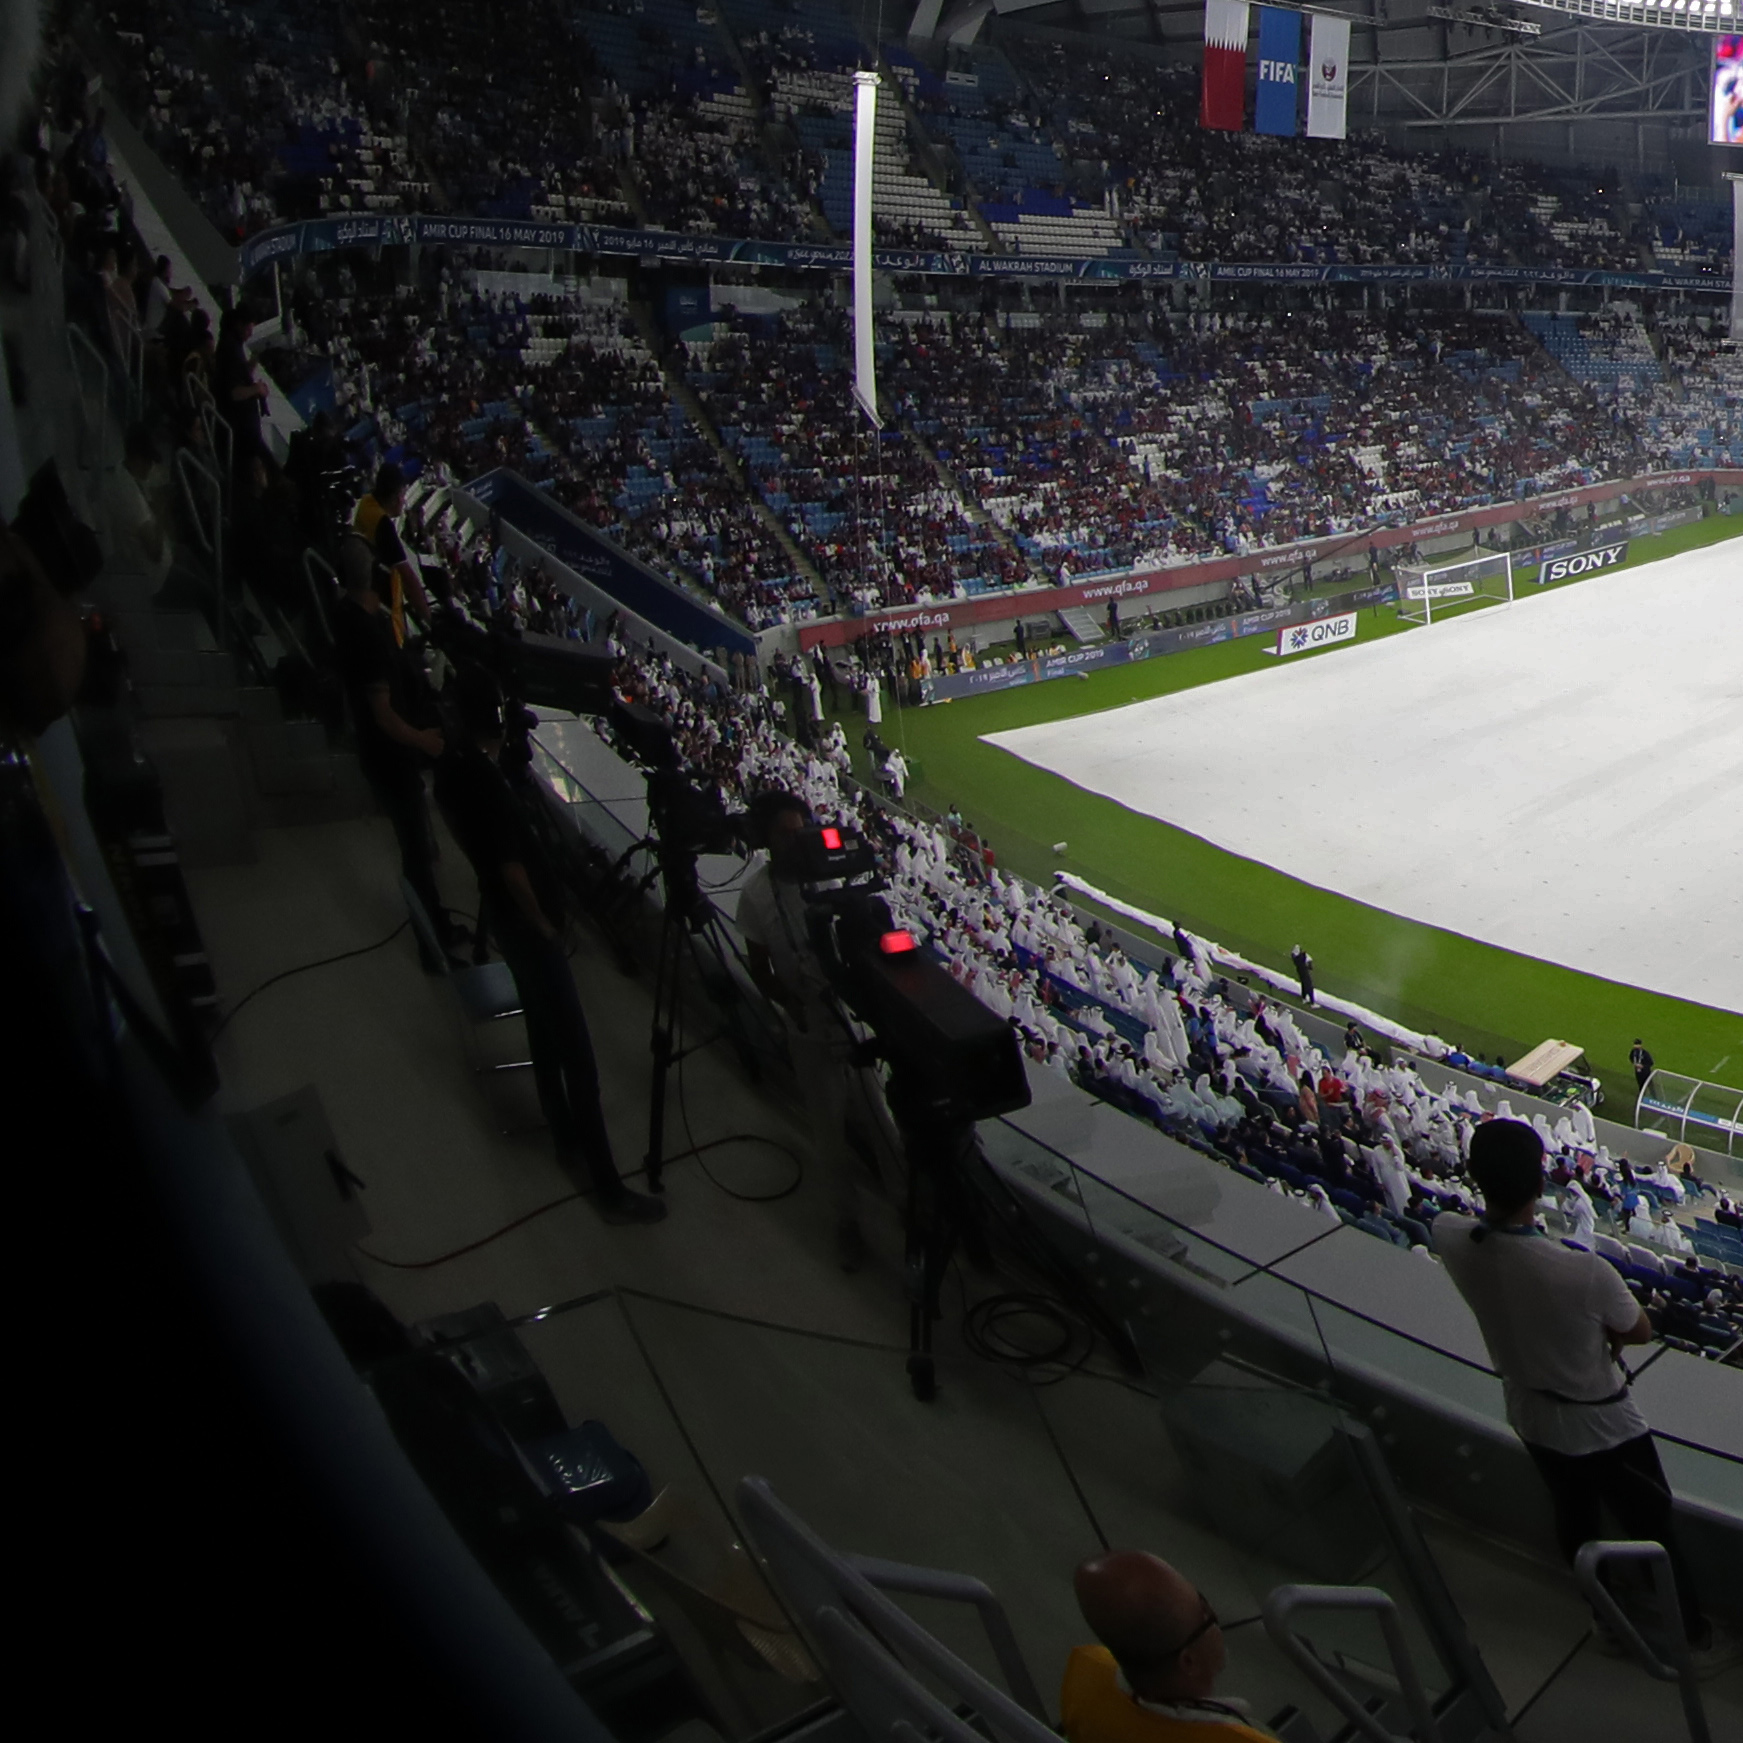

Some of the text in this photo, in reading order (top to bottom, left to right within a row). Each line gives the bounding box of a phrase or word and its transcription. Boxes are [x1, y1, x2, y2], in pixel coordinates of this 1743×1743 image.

[1260, 60, 1295, 84] FIFA
[422, 226, 565, 243] AMIR CUP FINAL 16 MAY 2019
[604, 235, 624, 246] 2019
[979, 262, 1073, 273] AL WAKRAH STADIUM
[1239, 267, 1253, 277] CUP
[1254, 267, 1274, 278] FINAL
[1286, 268, 1300, 278] MAY
[1662, 278, 1712, 287] AL WAKRAH
[1412, 521, 1460, 537] www.qfa.qa
[1550, 545, 1625, 581] SONY
[1083, 578, 1149, 599] www.qfa.qa
[1274, 609, 1292, 619] 2019
[1311, 618, 1350, 643] QNB
[1046, 649, 1104, 668] AMIR CUP 2019
